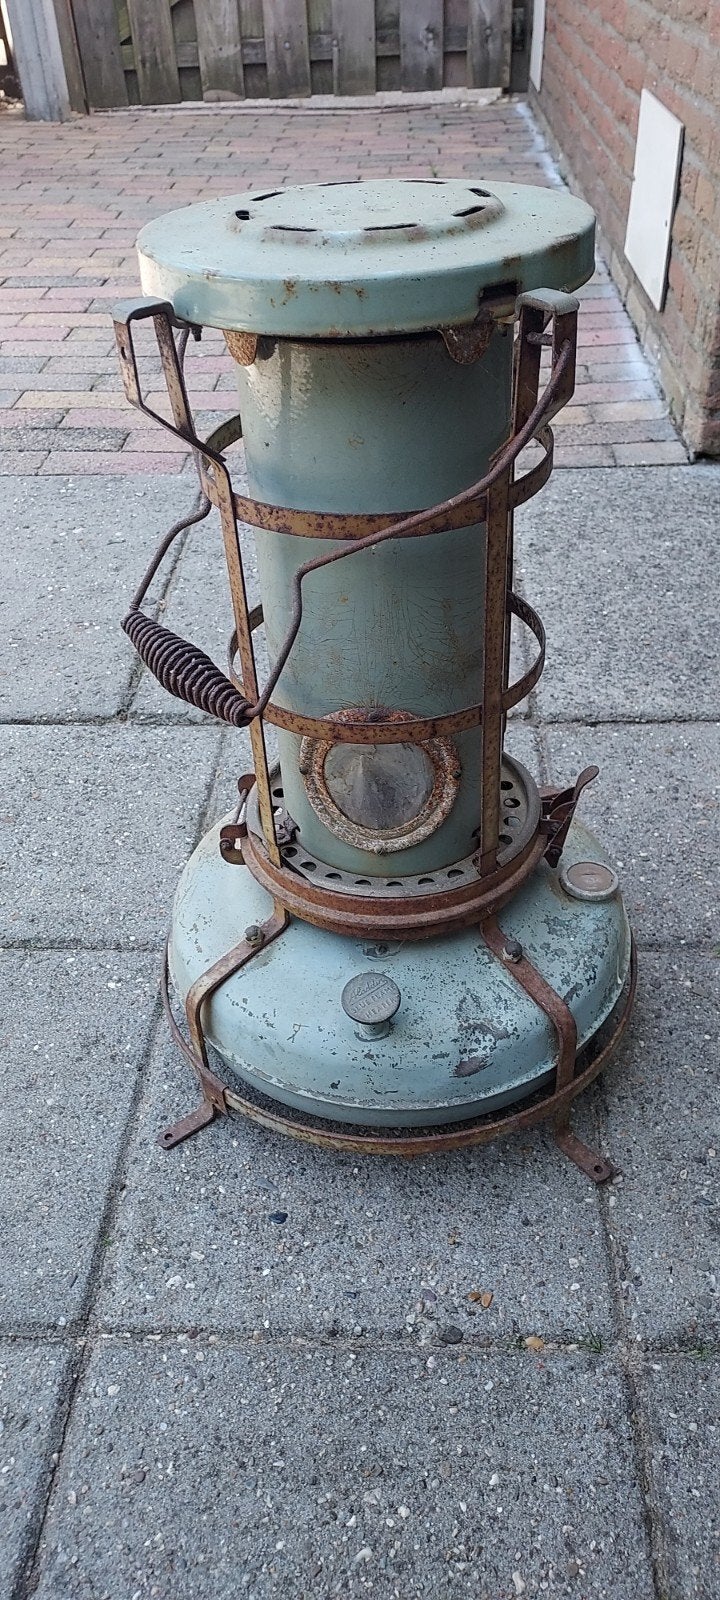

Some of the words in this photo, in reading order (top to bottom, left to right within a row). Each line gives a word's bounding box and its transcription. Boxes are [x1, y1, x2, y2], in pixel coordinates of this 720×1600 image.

[350, 999, 371, 1014] BLUE
[371, 984, 397, 1002] FLAME
[365, 997, 397, 1018] HEATER
